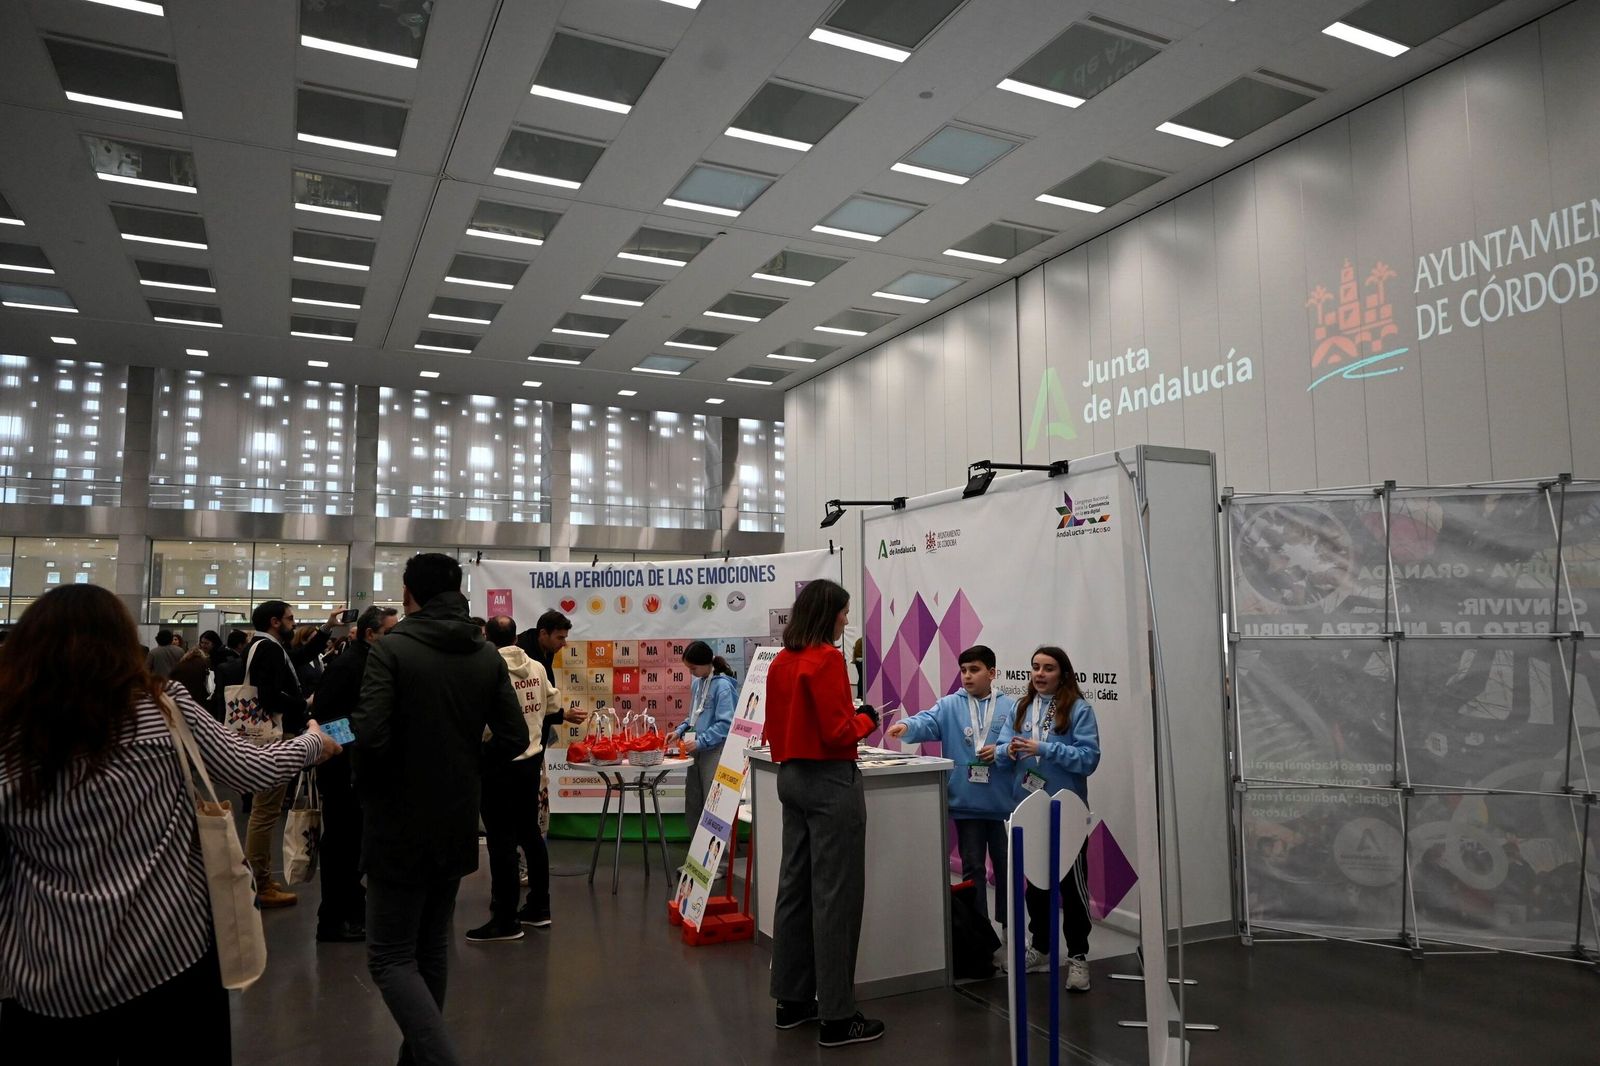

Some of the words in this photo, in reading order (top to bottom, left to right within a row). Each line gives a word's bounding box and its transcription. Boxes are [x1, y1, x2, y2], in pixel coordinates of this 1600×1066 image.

[1416, 298, 1453, 341] DE
[1082, 347, 1150, 388] Junta
[1083, 394, 1111, 424] de
[1117, 347, 1253, 416] Andalucía
[529, 570, 571, 589] TABLA
[574, 566, 645, 588] PERIÓDICA
[648, 568, 665, 586] DE
[668, 567, 694, 586] LAS
[697, 564, 776, 585] EMOCIONES
[494, 595, 506, 605] AM
[778, 615, 788, 625] NE
[571, 648, 577, 657] IL
[595, 647, 605, 656] SO
[622, 647, 630, 656] IN
[646, 647, 658, 656] MA
[725, 644, 736, 654] AB
[570, 673, 579, 683] PL
[595, 673, 605, 683] EX
[623, 673, 630, 683] IR
[647, 673, 658, 682] RN
[673, 672, 684, 682] HO
[1092, 674, 1118, 685] RUIZ
[514, 678, 540, 690] ROMPE
[526, 691, 535, 701] EL
[1097, 691, 1119, 701] Cádiz
[648, 700, 657, 709] FR
[675, 700, 682, 709] IC
[570, 727, 579, 737] DE
[572, 776, 601, 784] SORPRESA
